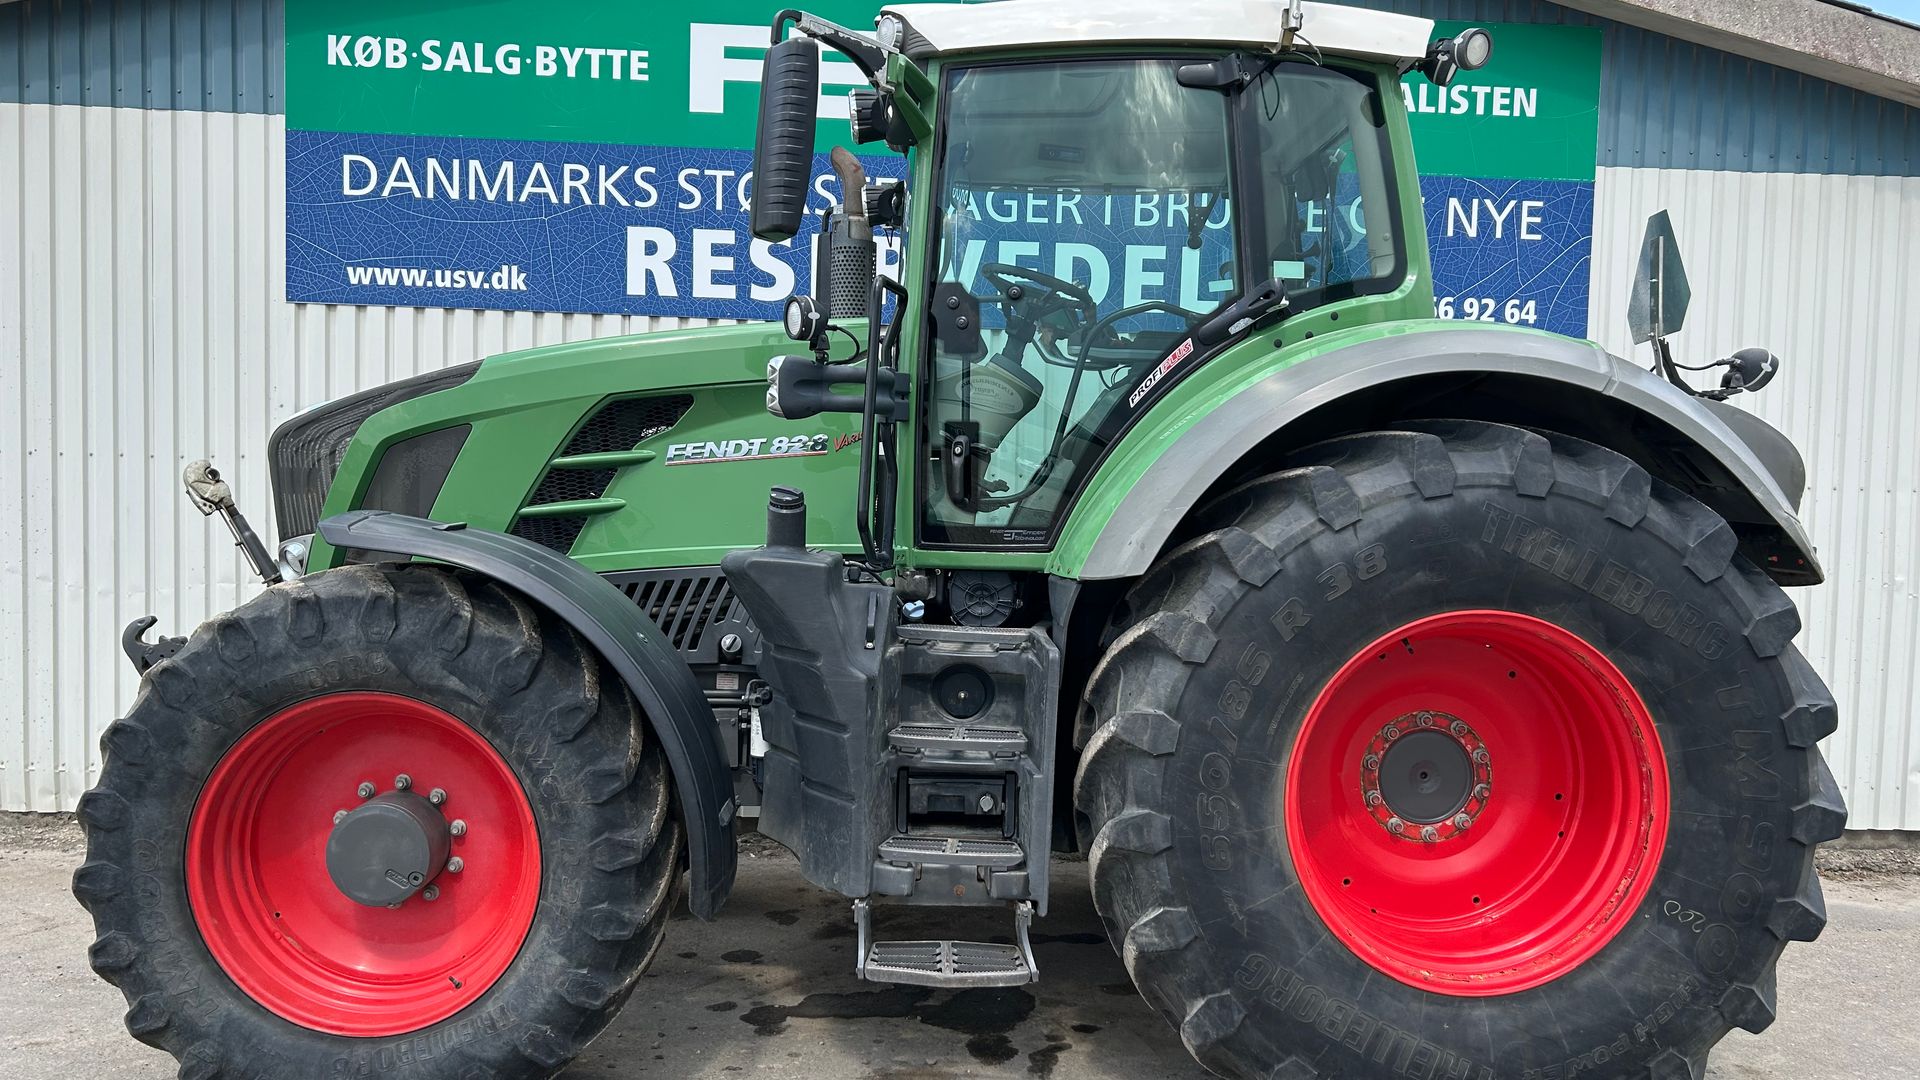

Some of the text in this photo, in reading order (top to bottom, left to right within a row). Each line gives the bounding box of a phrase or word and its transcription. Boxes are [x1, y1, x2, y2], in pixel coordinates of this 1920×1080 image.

[342, 154, 657, 207] DANMARKS
[1447, 197, 1544, 241] NYE
[346, 264, 527, 292] www.usv.dk
[1463, 297, 1496, 322] 92
[1504, 299, 1538, 324] 64
[665, 438, 768, 462] FENDT
[769, 434, 829, 453] 828
[1480, 501, 1730, 660] TRELLEBORG
[1197, 642, 1273, 872] 650/85
[1270, 597, 1312, 642] R
[1315, 542, 1390, 601] 38
[1633, 973, 1700, 1042] HIGH
